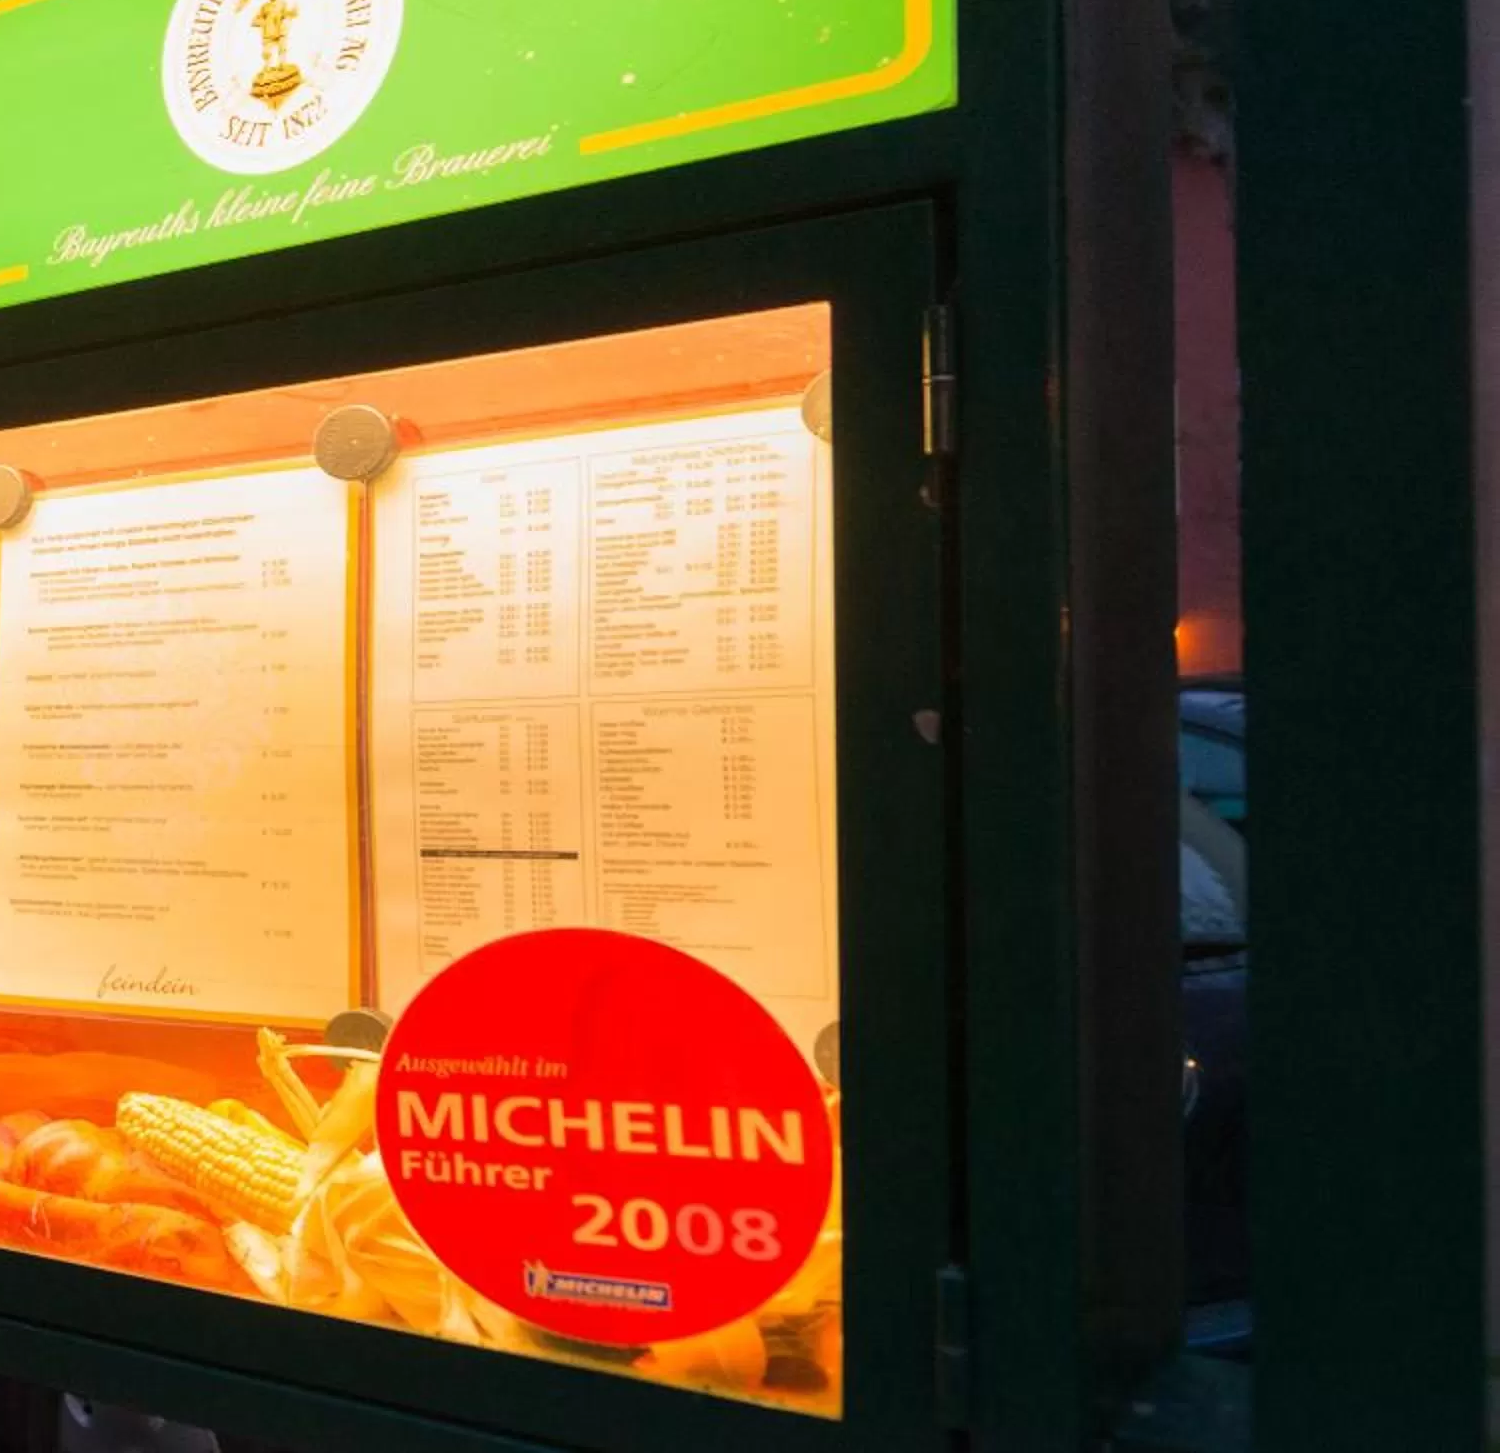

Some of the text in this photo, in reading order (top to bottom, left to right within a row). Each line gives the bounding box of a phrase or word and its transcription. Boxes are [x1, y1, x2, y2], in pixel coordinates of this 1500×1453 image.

[335, 36, 369, 74] AG
[220, 94, 329, 149] SEIT 1872
[46, 127, 559, 268] Bayreuths kleine feine Brauerei
[395, 1052, 568, 1079] Ausgewählt im
[396, 1090, 805, 1166] MICHELIN
[400, 1150, 553, 1191] Führer
[570, 1193, 783, 1262] 2008
